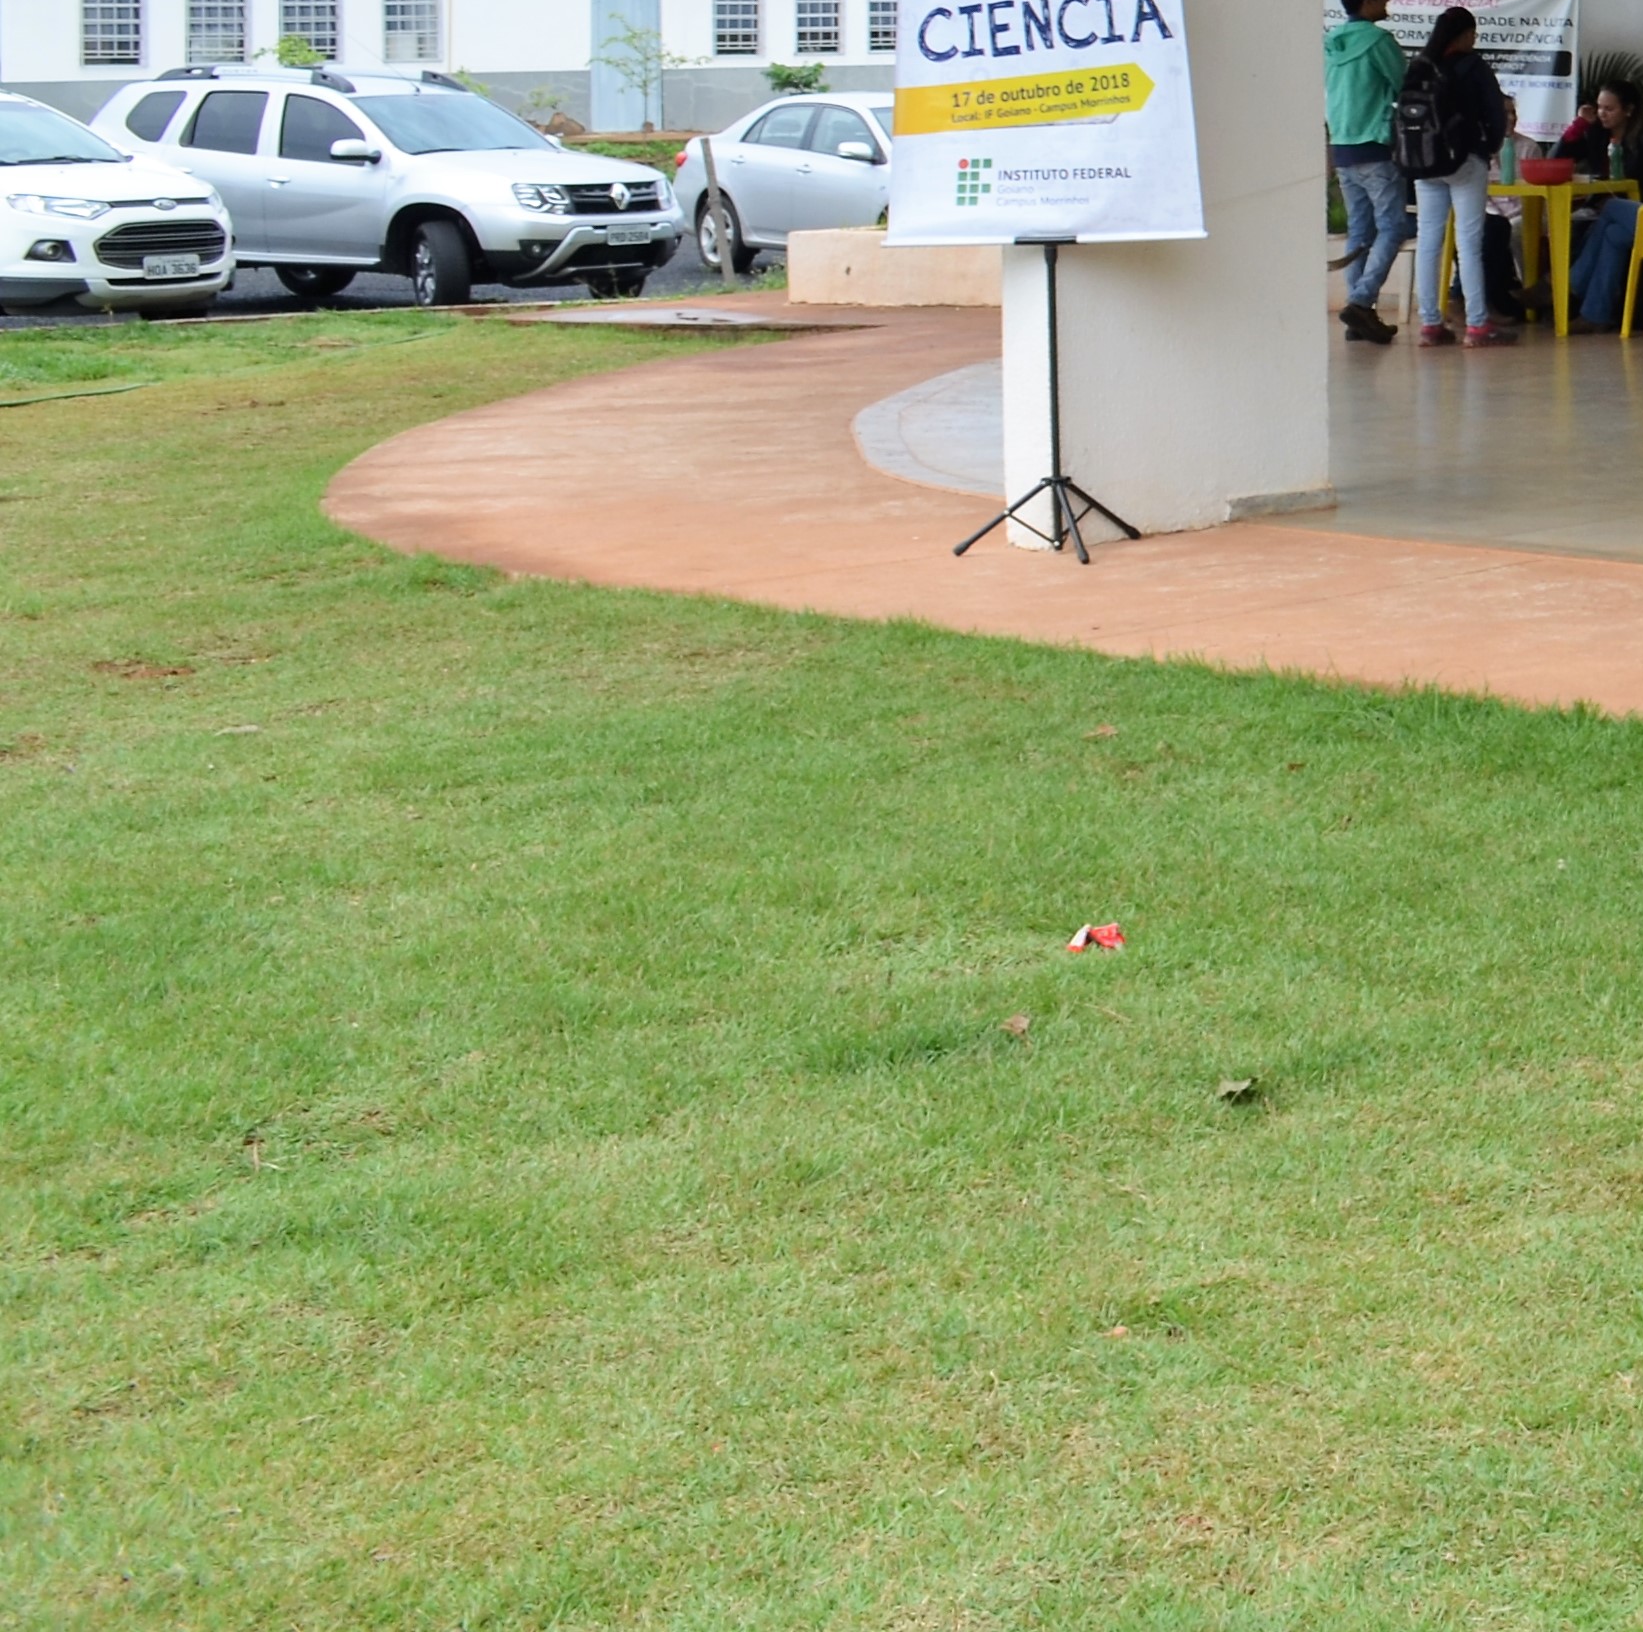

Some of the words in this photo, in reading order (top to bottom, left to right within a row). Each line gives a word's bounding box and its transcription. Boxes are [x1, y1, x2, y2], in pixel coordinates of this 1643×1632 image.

[1520, 16, 1540, 27] NA
[952, 91, 972, 108] 17
[976, 90, 995, 106] de
[1000, 84, 1061, 103] outubro
[1066, 80, 1084, 95] de
[1089, 72, 1131, 93] 2018
[996, 105, 1032, 119] Goiano
[1039, 101, 1078, 116] Campus
[1080, 95, 1131, 109] Morrinhos
[997, 168, 1069, 181] INSTITUTO
[1072, 167, 1132, 180] FEDERAL
